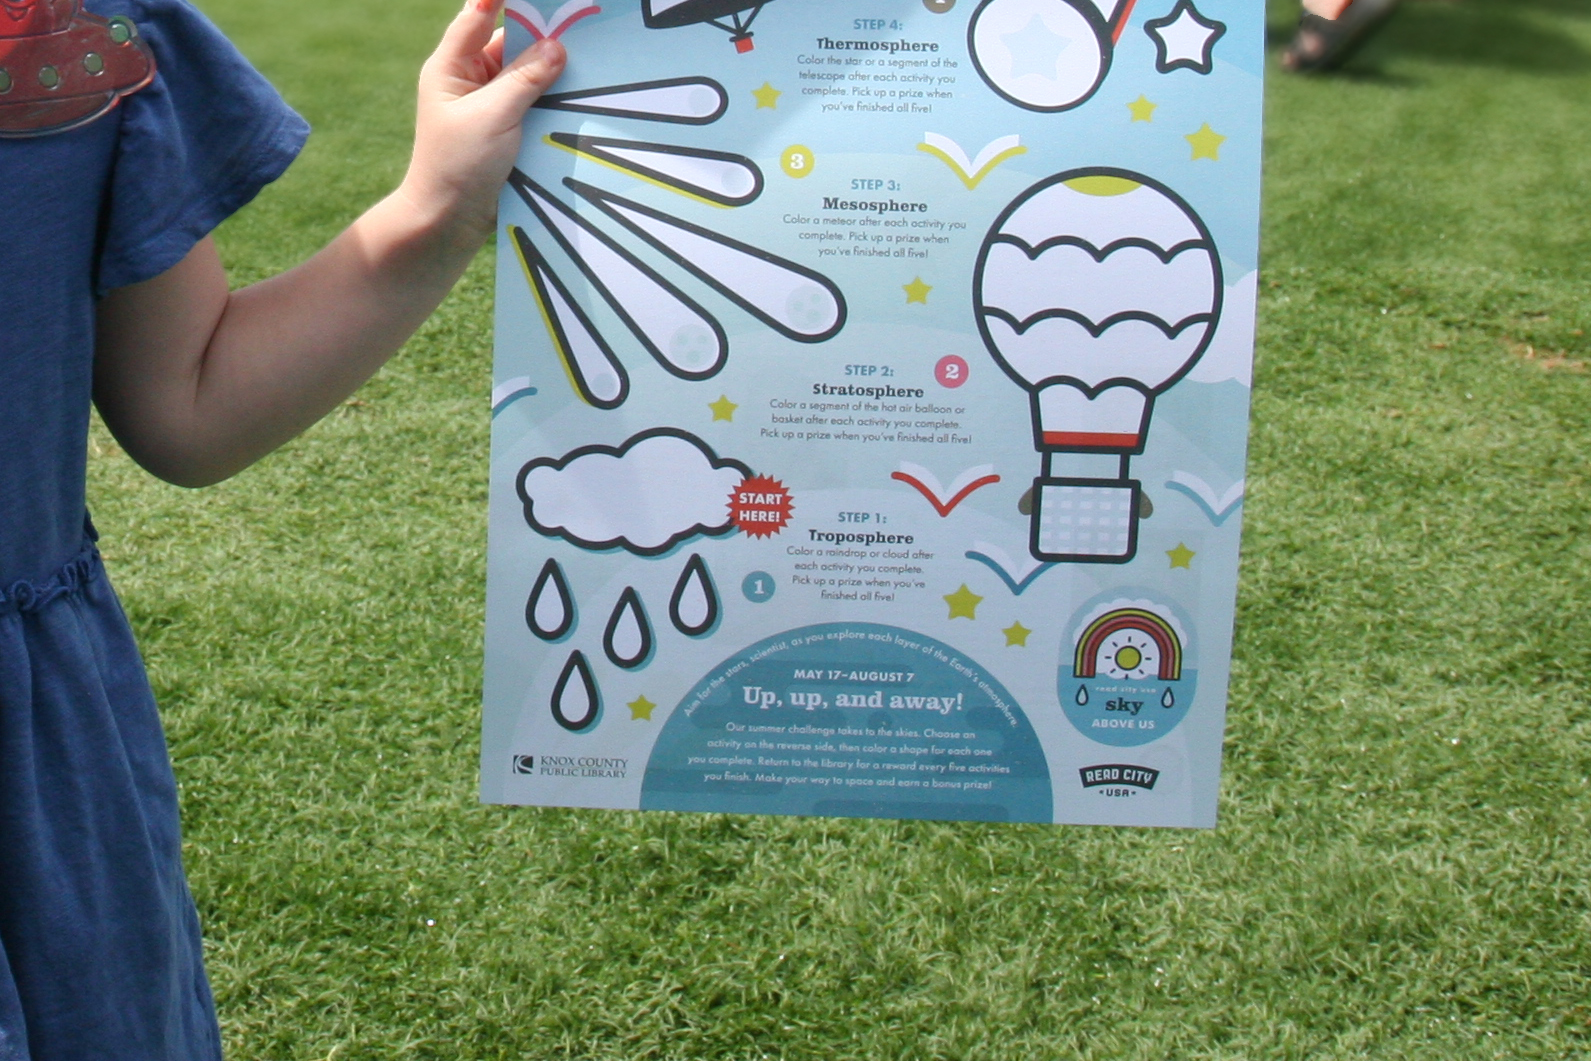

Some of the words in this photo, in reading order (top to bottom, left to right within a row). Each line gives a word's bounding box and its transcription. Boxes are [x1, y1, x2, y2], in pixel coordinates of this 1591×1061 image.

[853, 18, 886, 30] STEP
[889, 19, 903, 30] 4:
[817, 38, 939, 54] Thermosphere
[797, 55, 824, 65] Color
[827, 55, 842, 65] the
[845, 56, 862, 66] star
[865, 58, 875, 66] or
[888, 58, 928, 69] segment
[931, 58, 940, 68] of
[943, 58, 958, 68] the
[799, 71, 845, 82] telescope
[848, 71, 870, 81] after
[873, 72, 897, 82] each
[900, 73, 935, 85] activity
[937, 76, 956, 85] you
[801, 86, 848, 97] complete.
[852, 87, 871, 96] Pick
[873, 90, 887, 98] up
[898, 88, 924, 99] prize
[926, 89, 953, 98] when
[821, 102, 854, 113] you've
[856, 102, 894, 112] finished
[897, 103, 908, 113] all
[911, 103, 933, 113] five!
[790, 153, 805, 170] 3
[851, 179, 883, 190] STEP
[887, 180, 901, 191] 3:
[822, 197, 928, 215] Mesosphere
[844, 364, 877, 376] STEP
[880, 365, 894, 377] 2:
[945, 363, 959, 379] 2
[812, 383, 924, 399] Stratosphere
[769, 399, 797, 410] Color
[809, 402, 850, 413] segment
[852, 400, 862, 411] of
[864, 401, 879, 411] the
[881, 402, 897, 412] hot
[899, 402, 912, 413] air
[915, 403, 952, 414] balloon
[772, 414, 803, 425] basket
[805, 414, 828, 425] after
[830, 415, 855, 426] each
[857, 416, 892, 429] activity
[894, 419, 912, 429] you
[914, 418, 962, 430] complete.
[760, 428, 779, 438] Pick
[781, 431, 795, 441] up
[806, 430, 831, 442] prize
[833, 430, 858, 440] when
[862, 432, 895, 444] you've
[897, 432, 934, 443] finished
[936, 433, 949, 443] all
[951, 433, 972, 444] five!
[739, 492, 783, 505] START
[739, 511, 780, 523] HERE!
[838, 512, 870, 523] STEP
[875, 513, 887, 524] 1:
[808, 529, 914, 546] Troposphere
[786, 545, 815, 556] Color
[825, 547, 867, 559] raindrop
[869, 550, 880, 558] or
[882, 548, 909, 559] cloud
[911, 549, 935, 560] after
[794, 561, 818, 571] each
[820, 562, 855, 573] activity
[857, 565, 876, 575] you
[877, 564, 924, 575] complete.
[754, 580, 764, 594] 1
[792, 575, 811, 585] Pick
[814, 577, 826, 588] up
[838, 577, 862, 589] prize
[864, 578, 891, 588] when
[893, 579, 926, 590] you've
[821, 590, 858, 601] finished
[860, 591, 872, 601] all
[874, 591, 895, 602] five!
[793, 669, 824, 679] MAY
[906, 673, 915, 682] 7
[742, 686, 783, 710] Up,
[789, 693, 828, 711] up,
[835, 691, 883, 709] and
[889, 692, 964, 715] away!
[1105, 698, 1144, 716] sky
[725, 721, 745, 732] Our
[748, 724, 786, 732] summer
[788, 724, 835, 737] challenge
[838, 726, 863, 736] takes
[865, 728, 876, 736] to
[877, 727, 893, 737] the
[895, 728, 921, 738] skies.
[923, 728, 960, 739] Choose
[1092, 719, 1135, 729] ABOVE
[1138, 720, 1155, 729] US
[540, 755, 575, 767] KNOX
[578, 757, 628, 768] COUNTY
[540, 767, 579, 777] PUBLIC
[581, 768, 626, 778] LIBRARY
[1085, 768, 1119, 783] READ
[1123, 769, 1153, 784] CITY
[1106, 789, 1129, 797] USA
